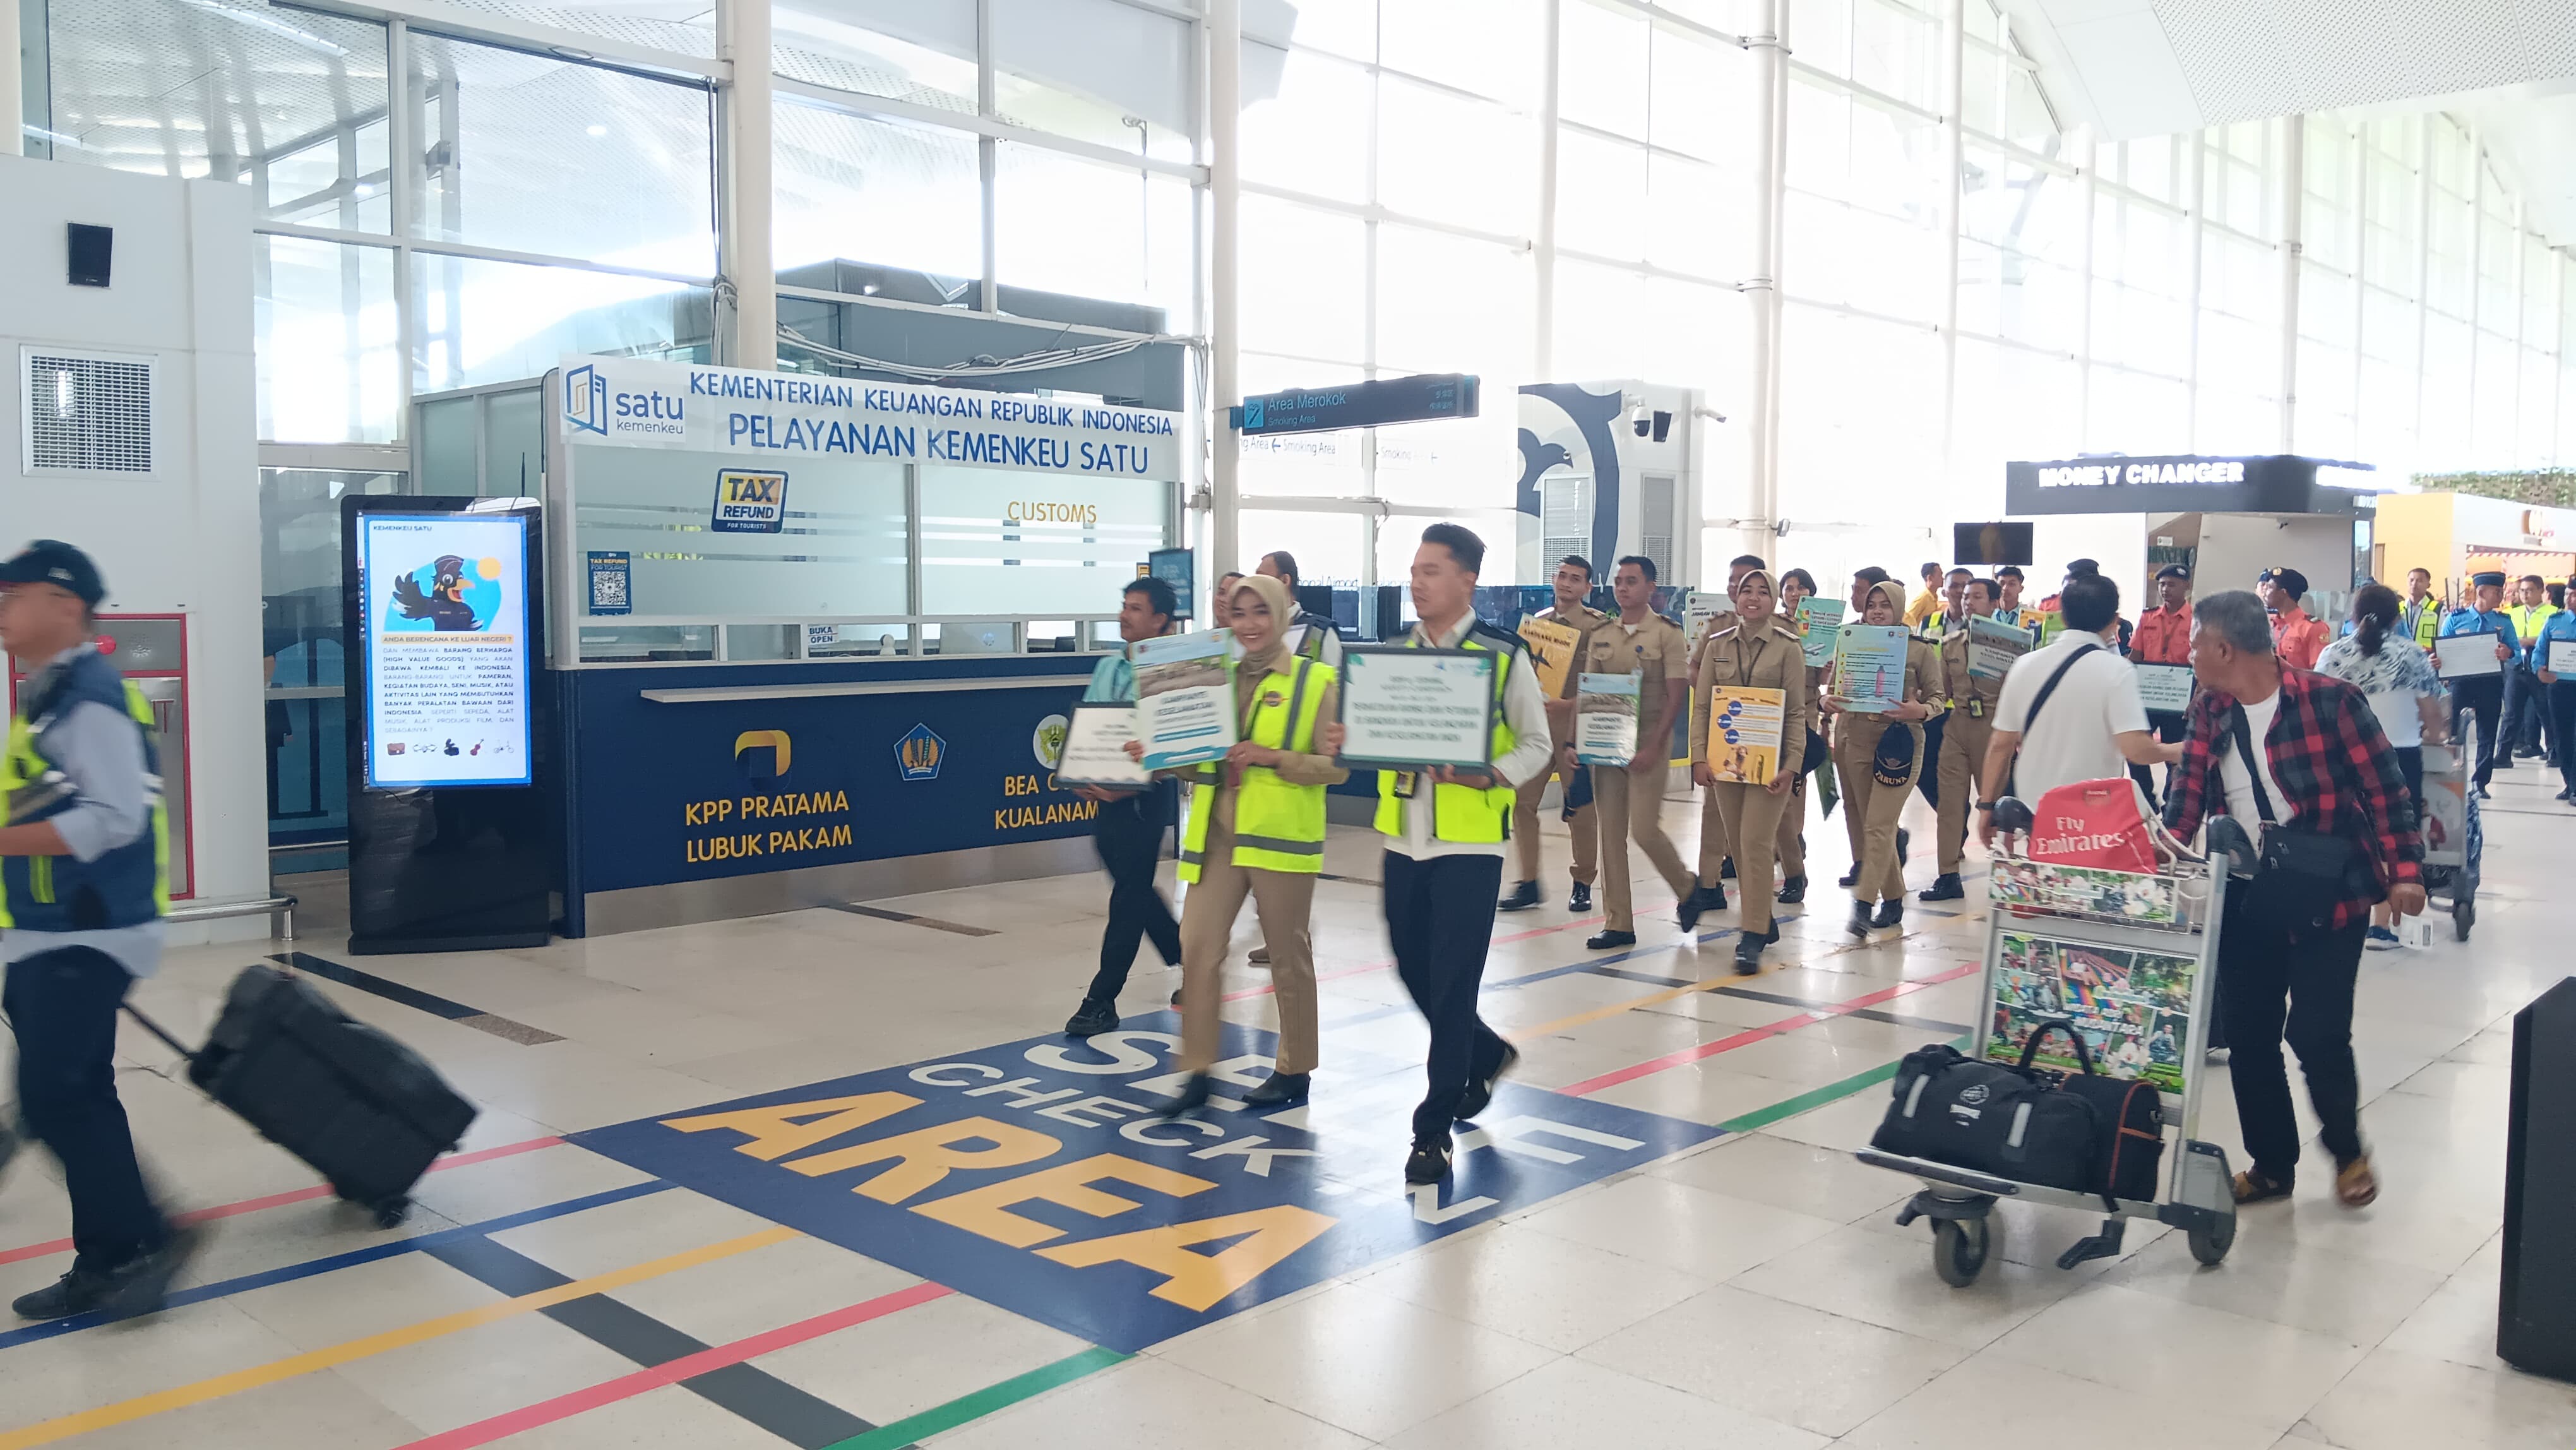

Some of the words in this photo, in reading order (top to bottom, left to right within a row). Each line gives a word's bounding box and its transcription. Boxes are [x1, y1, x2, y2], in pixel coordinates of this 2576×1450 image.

[616, 390, 684, 420] satu
[690, 371, 853, 408] KEMENTERIAN
[865, 388, 982, 419] KEUANGAN
[991, 400, 1073, 428] REPUBLIK
[1082, 409, 1173, 436] INDONESIA
[1268, 397, 1294, 412] Area
[1297, 392, 1346, 409] Merokok
[617, 418, 684, 434] kemenkeu
[1268, 415, 1297, 427] Smoking
[1298, 414, 1316, 424] Area
[729, 414, 915, 457] PELAYANAN
[927, 429, 1070, 468] KEMENKEU
[1080, 441, 1148, 474] SATU
[1283, 438, 1317, 455] Smoking
[1318, 441, 1336, 454] Area
[2038, 465, 2122, 488] MONEY
[2125, 462, 2245, 484] CHANGER
[728, 477, 777, 503] TAX
[723, 505, 774, 519] REFUND
[1007, 501, 1097, 524] CUSTOMS
[810, 635, 833, 644] OPEN
[1005, 775, 1039, 796] BEA
[686, 799, 732, 826] KPP
[741, 790, 849, 820] PRATAMA
[995, 800, 1099, 830] KUALANAM
[2056, 816, 2085, 832] Fly
[687, 833, 763, 863] LUBUK
[769, 824, 852, 854] PAKAM
[2035, 832, 2126, 855] Emirates
[1023, 1030, 1647, 1165] SEF
[908, 1062, 1324, 1178] CHECK
[657, 1091, 1340, 1313] AREA
